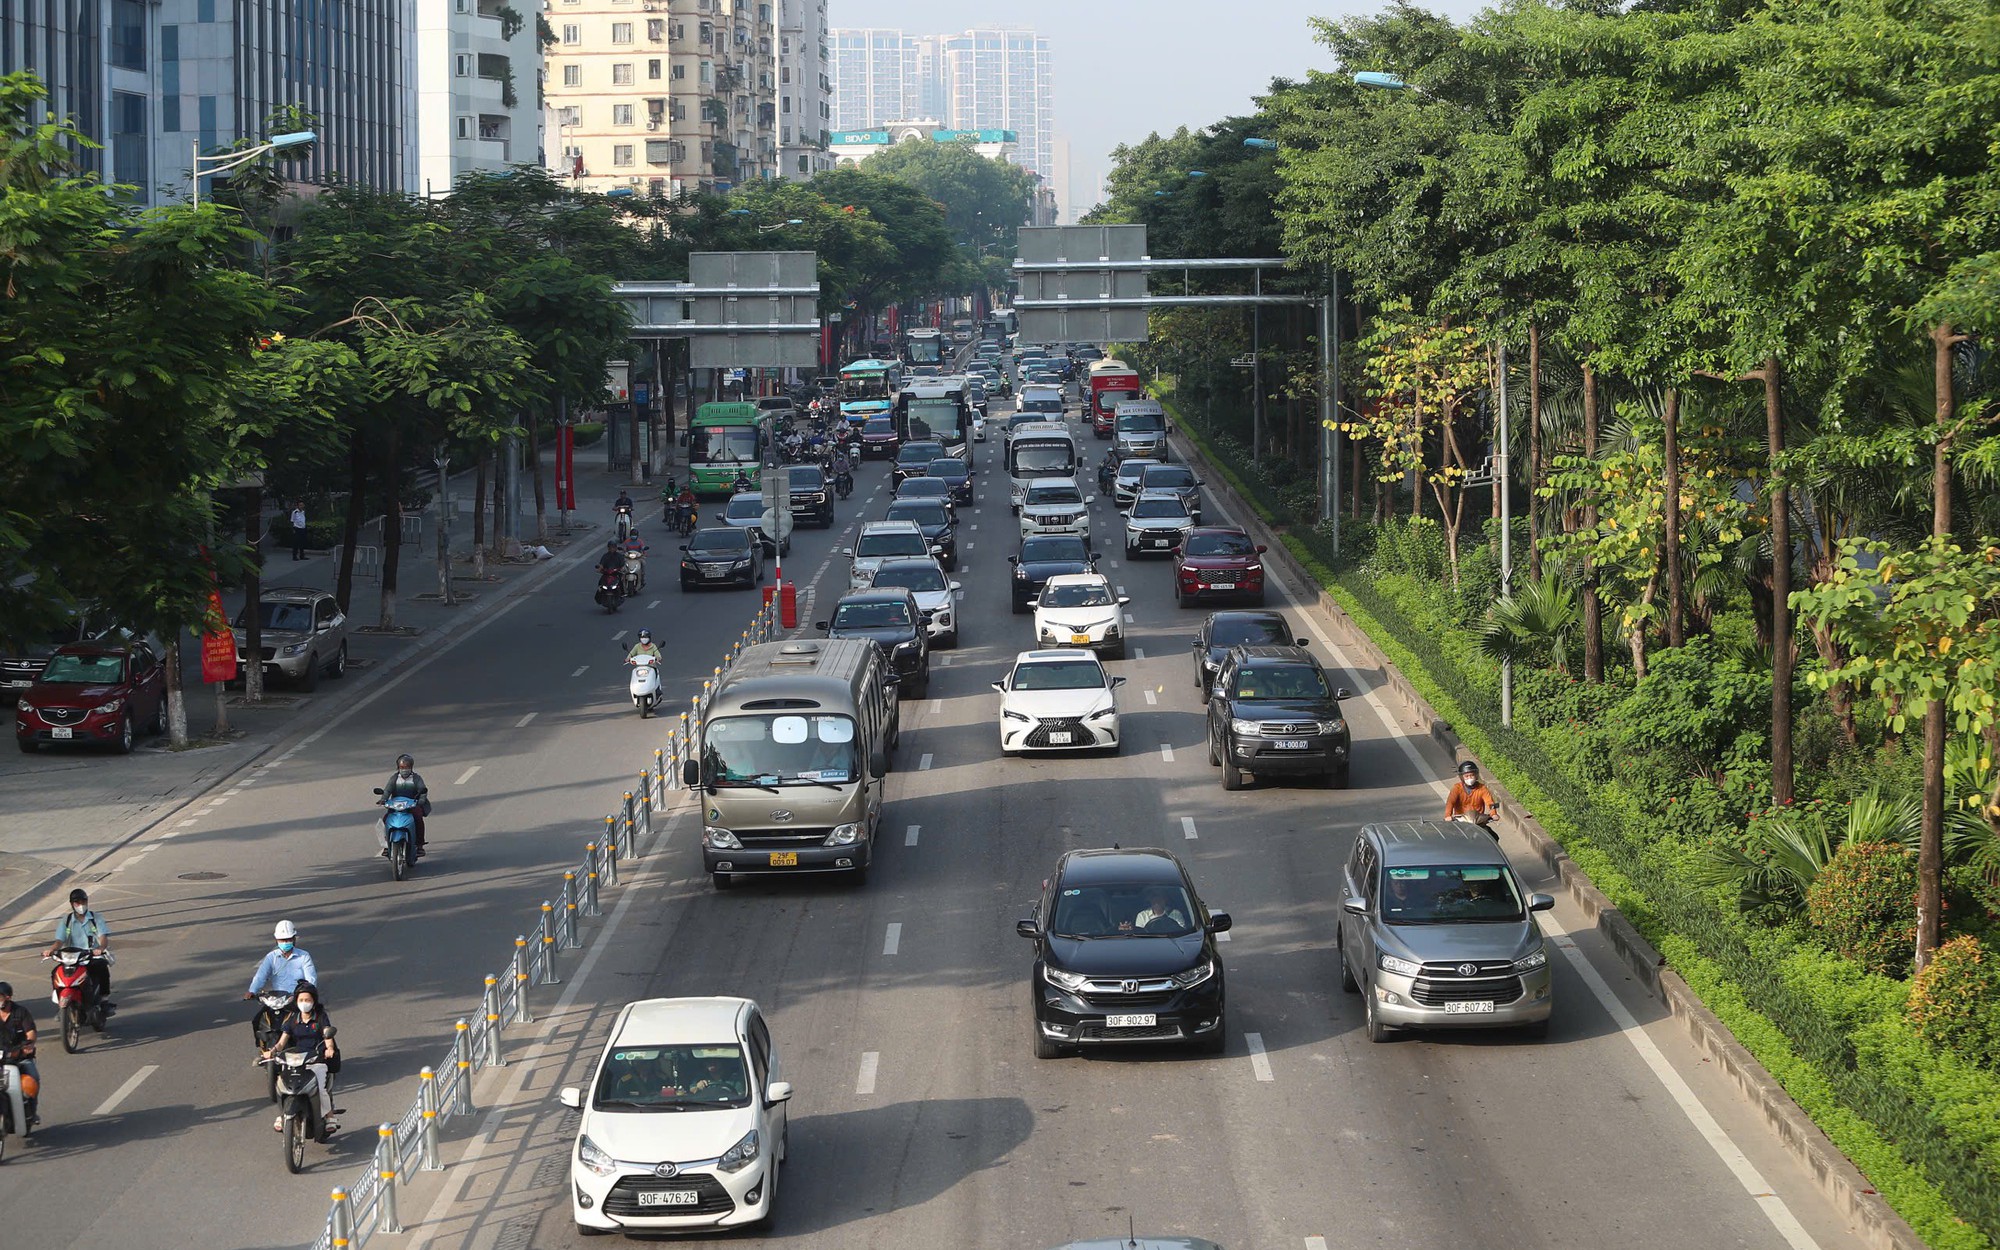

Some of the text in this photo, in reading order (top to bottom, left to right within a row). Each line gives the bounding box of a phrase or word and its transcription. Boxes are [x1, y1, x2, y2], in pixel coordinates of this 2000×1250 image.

[845, 135, 863, 143] BIDV
[1446, 1002, 1493, 1013] 30F-607.28
[1107, 1015, 1155, 1026] 30F-902.97
[640, 1192, 697, 1205] 30F-476.25
